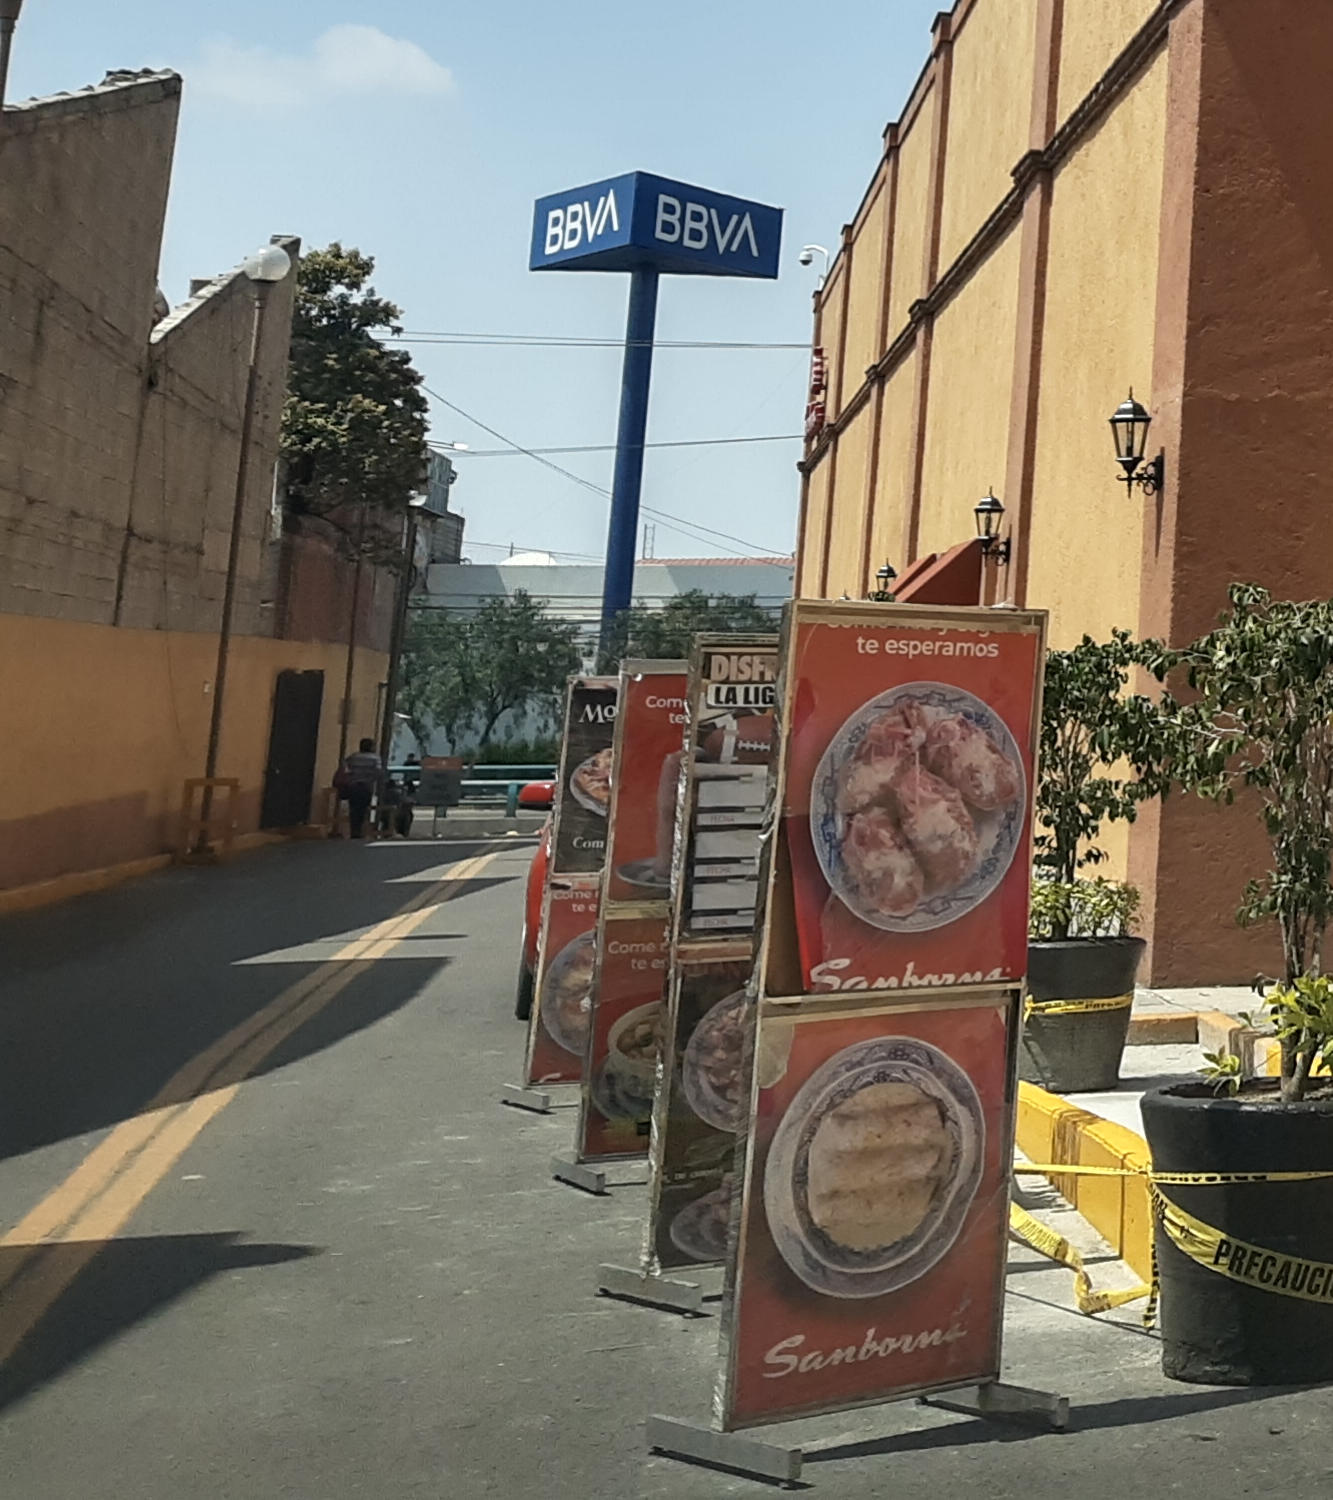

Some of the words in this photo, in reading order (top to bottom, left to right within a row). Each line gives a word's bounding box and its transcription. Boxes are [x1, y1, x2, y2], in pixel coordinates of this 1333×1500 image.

[544, 188, 619, 256] BBVA
[654, 193, 759, 258] BBVA
[856, 636, 879, 654] te
[885, 639, 999, 659] esperamos
[714, 686, 738, 705] LA
[763, 1322, 968, 1378] Sanborns
